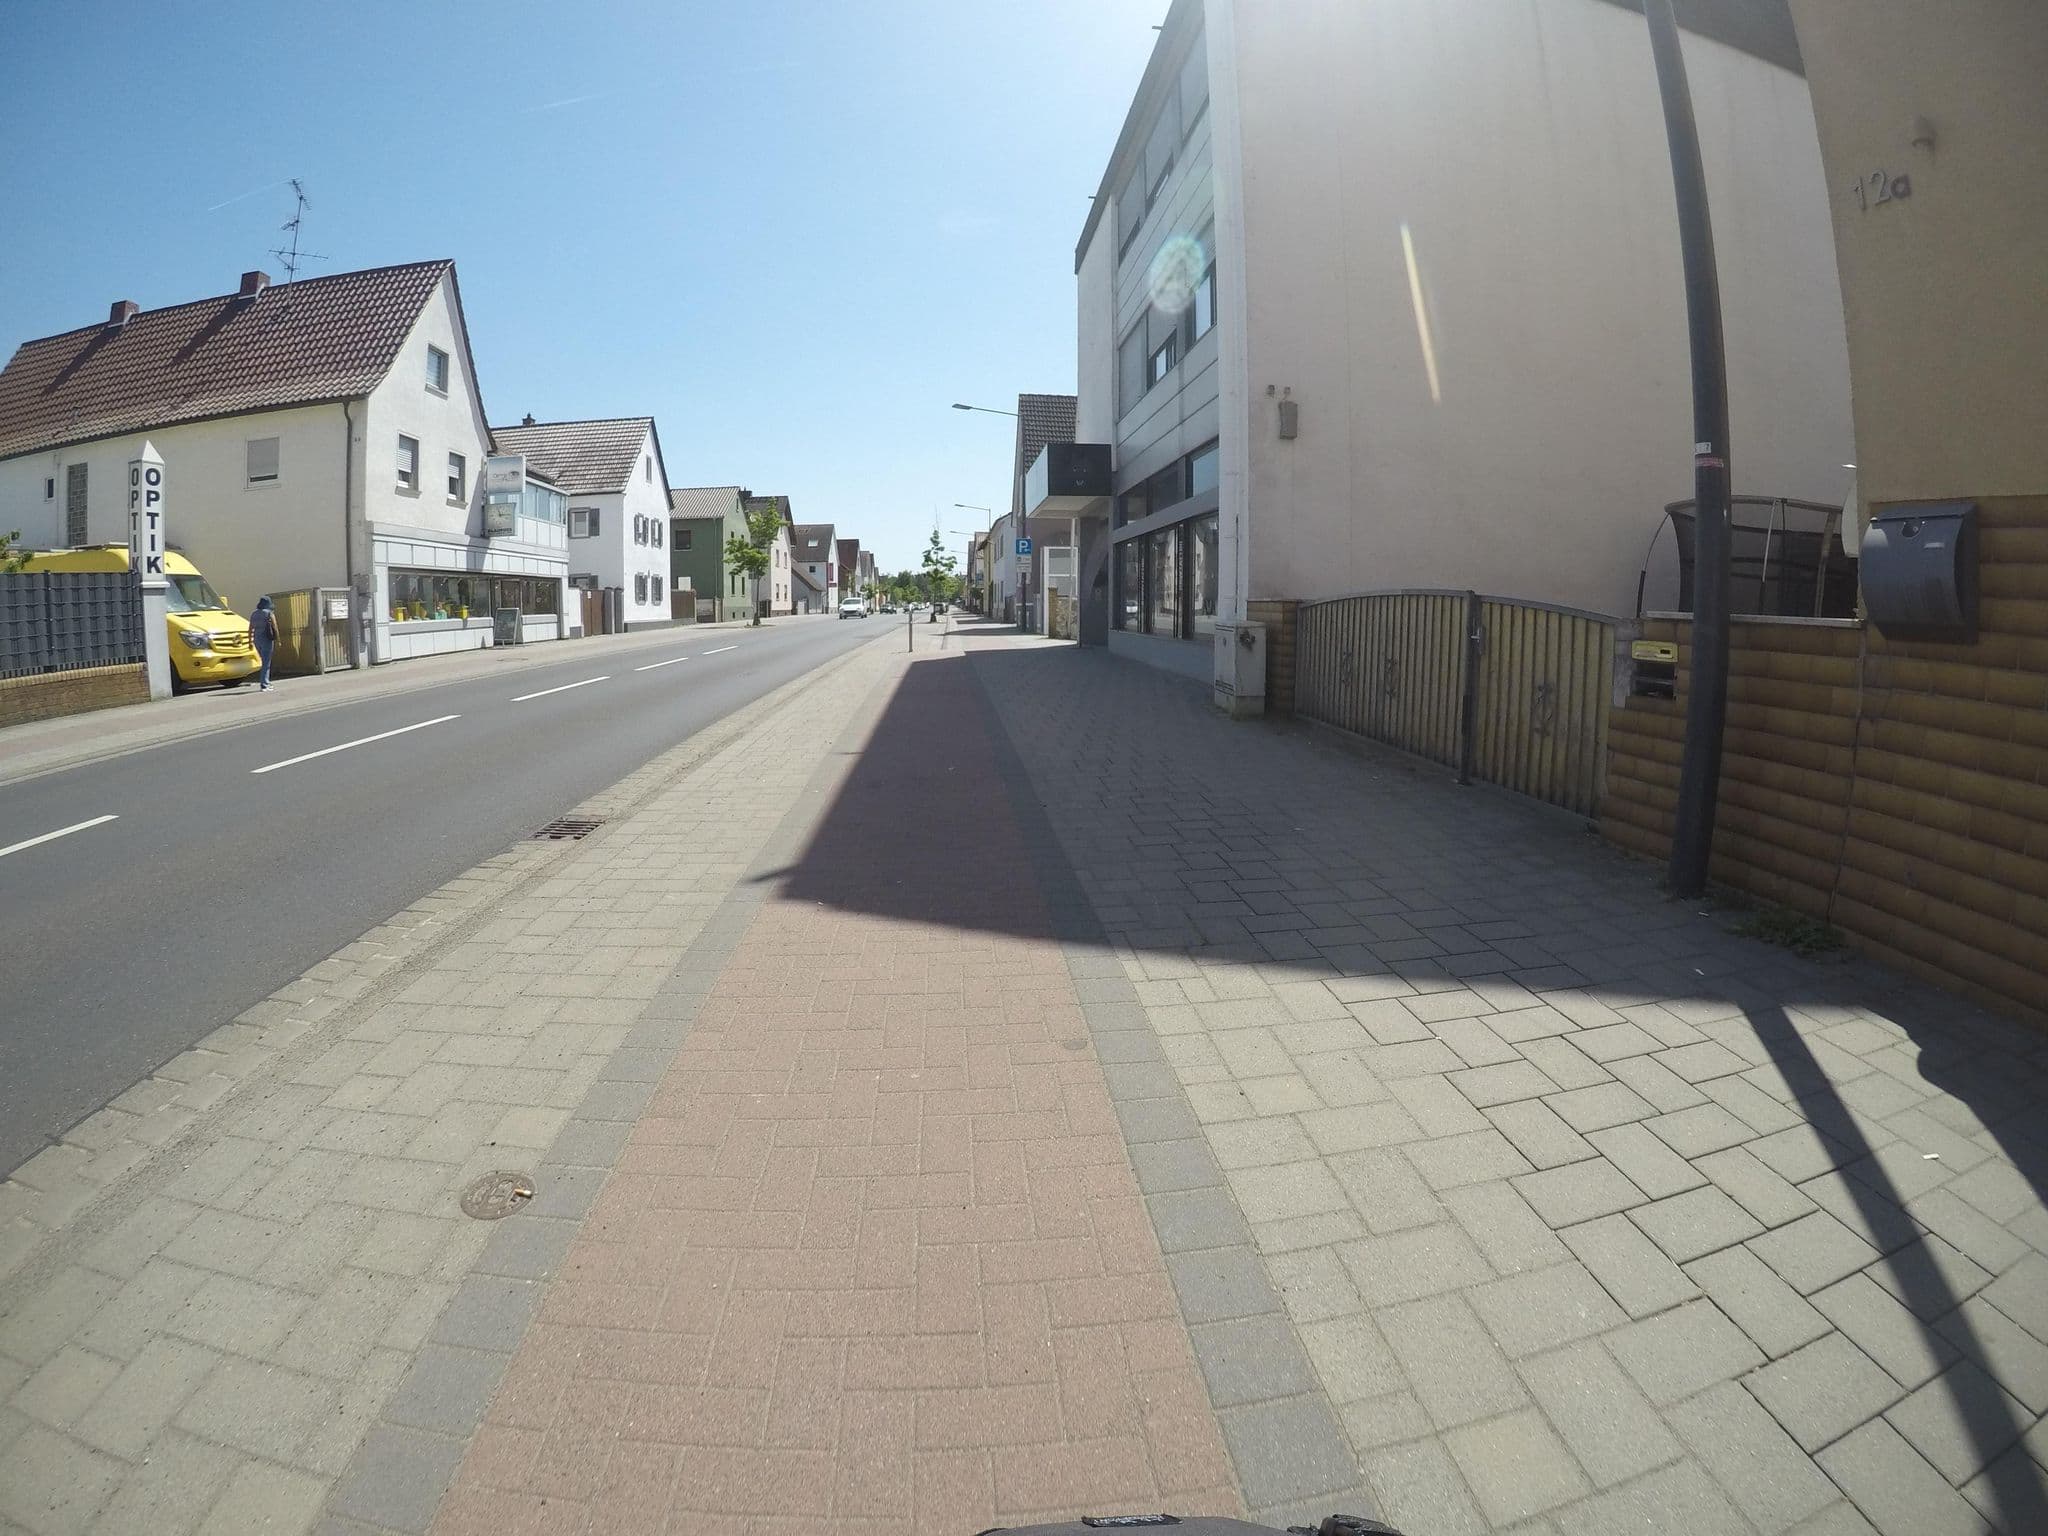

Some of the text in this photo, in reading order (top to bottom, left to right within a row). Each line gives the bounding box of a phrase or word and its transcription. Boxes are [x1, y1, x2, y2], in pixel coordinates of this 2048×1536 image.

[1852, 169, 1912, 211] 12a
[145, 468, 161, 573] OPTIK
[1018, 540, 1029, 553] P
